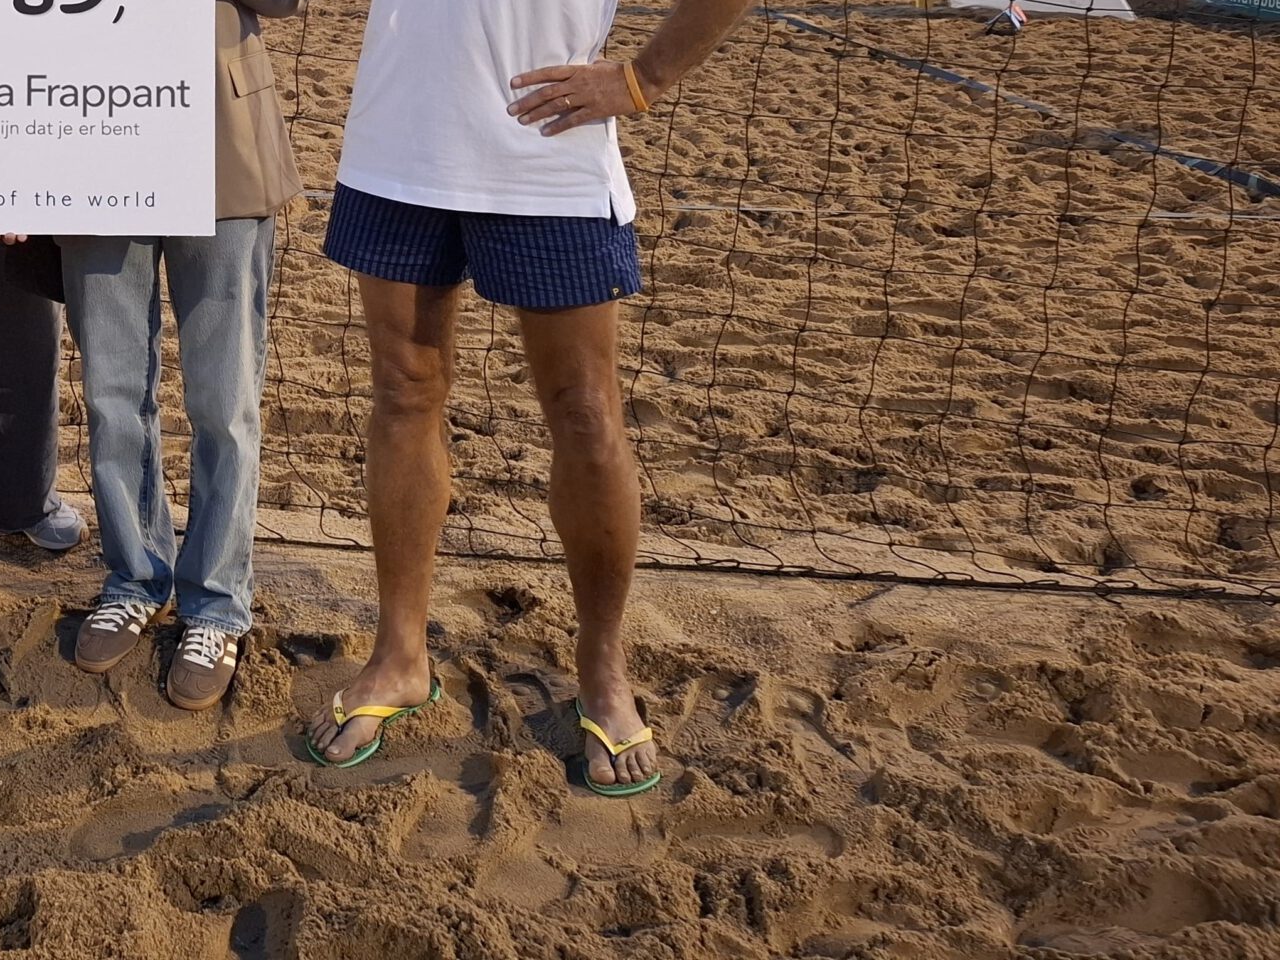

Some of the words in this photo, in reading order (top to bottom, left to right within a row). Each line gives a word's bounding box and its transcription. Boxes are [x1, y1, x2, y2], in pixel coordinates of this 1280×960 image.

[26, 74, 191, 118] Frappant
[25, 119, 54, 136] dat
[57, 120, 73, 140] je
[78, 124, 96, 136] er
[101, 119, 140, 136] bent
[34, 190, 72, 207] the
[87, 191, 155, 208] world
